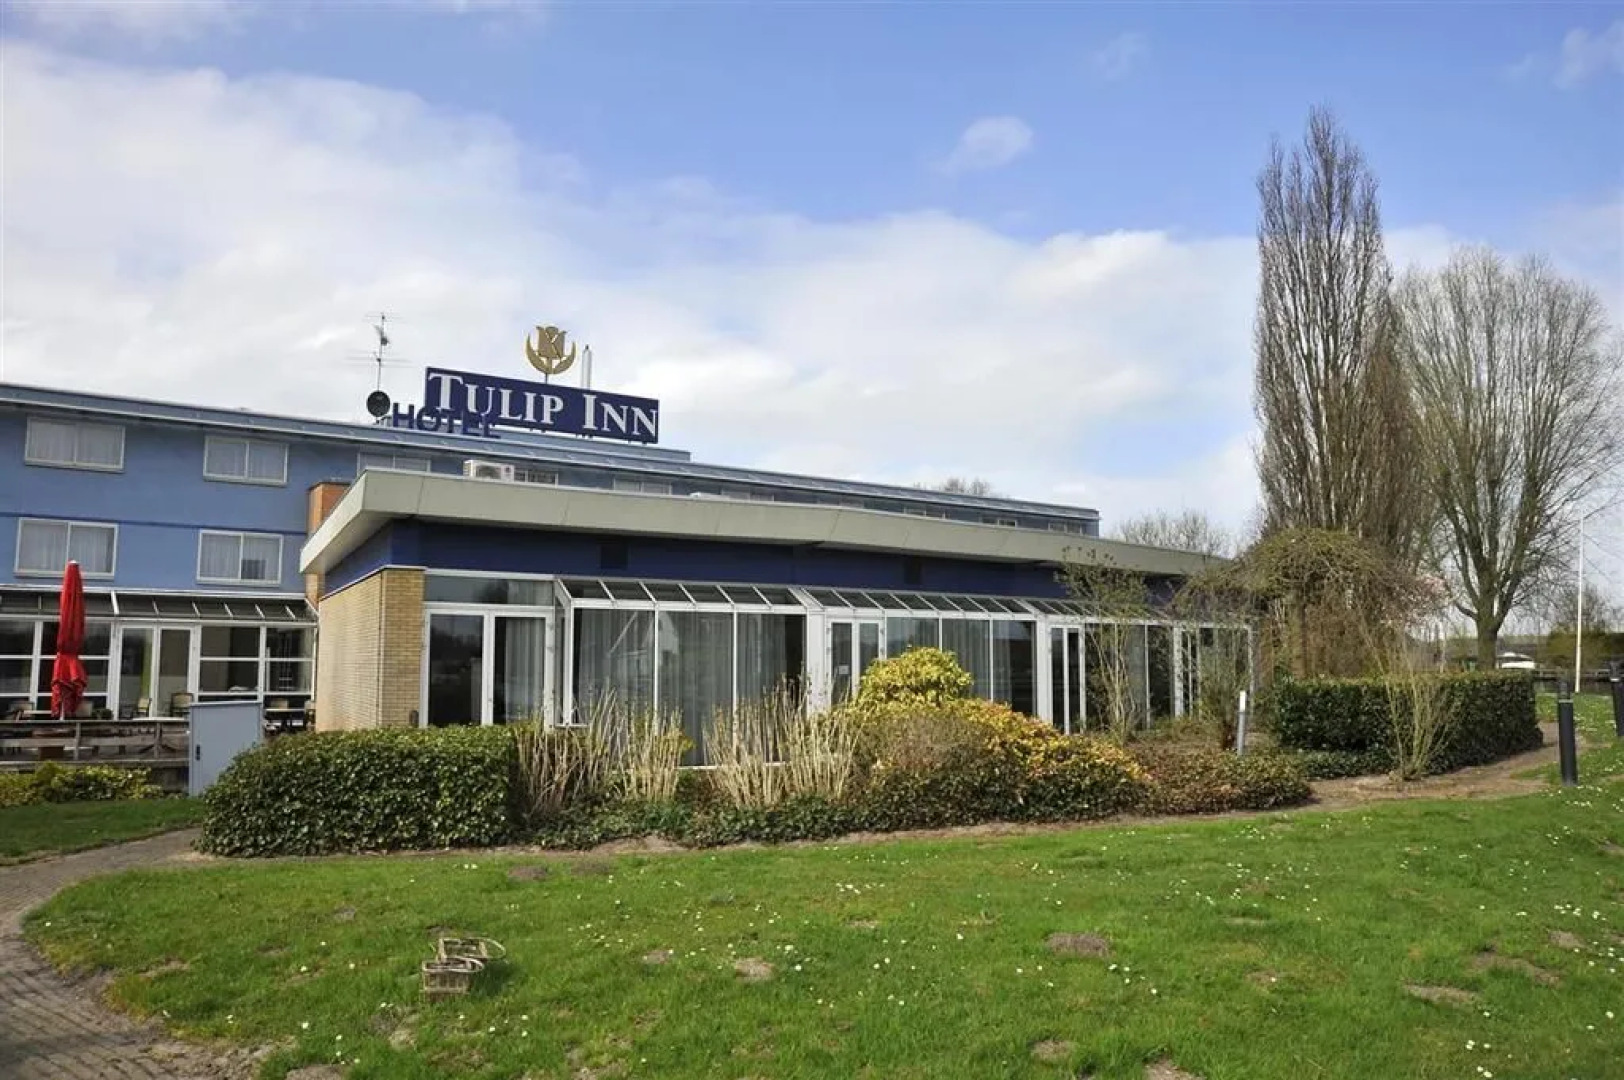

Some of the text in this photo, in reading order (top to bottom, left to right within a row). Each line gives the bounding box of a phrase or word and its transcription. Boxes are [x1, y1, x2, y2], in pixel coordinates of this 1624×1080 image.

[393, 402, 500, 439] HOTEL
[428, 373, 657, 437] TULIP INN
